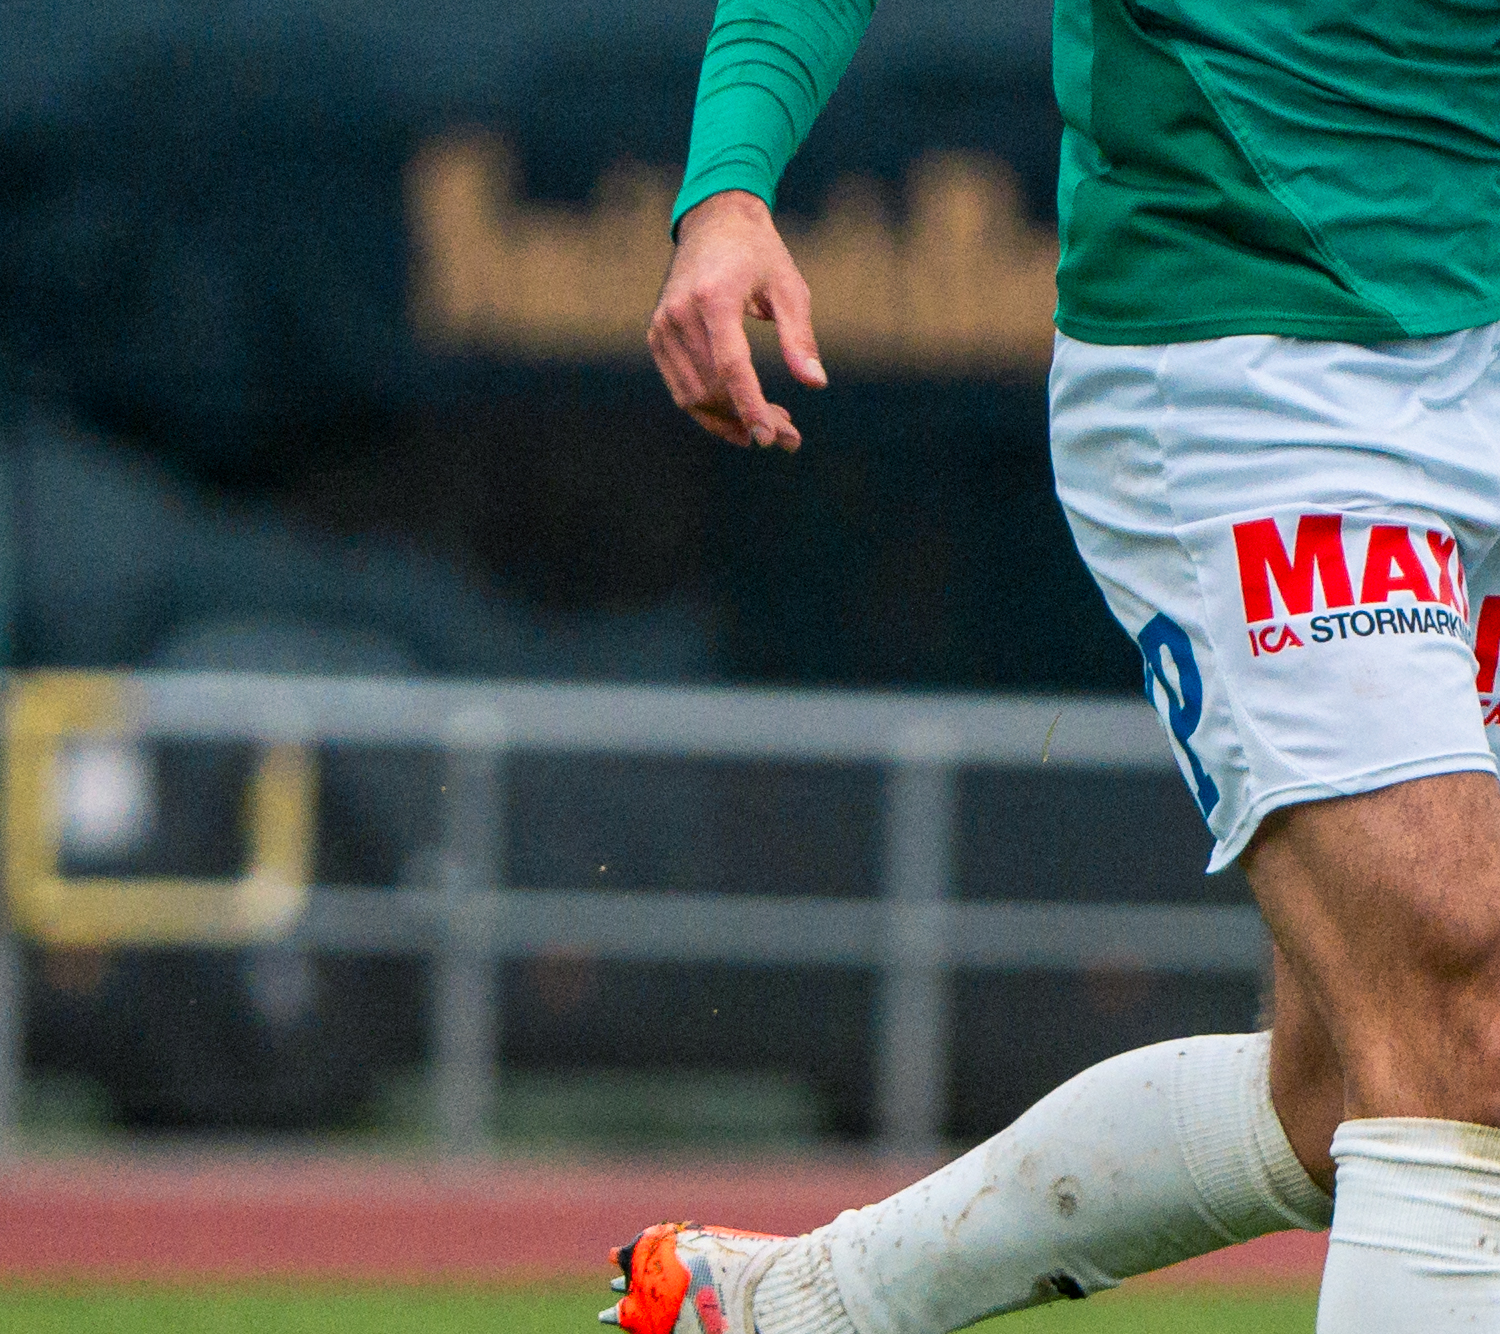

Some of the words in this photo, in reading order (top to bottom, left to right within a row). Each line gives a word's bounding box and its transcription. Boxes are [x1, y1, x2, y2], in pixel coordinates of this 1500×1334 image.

[1248, 623, 1304, 657] ICA
[1310, 608, 1471, 644] STORMARK
[1137, 611, 1221, 820] P
